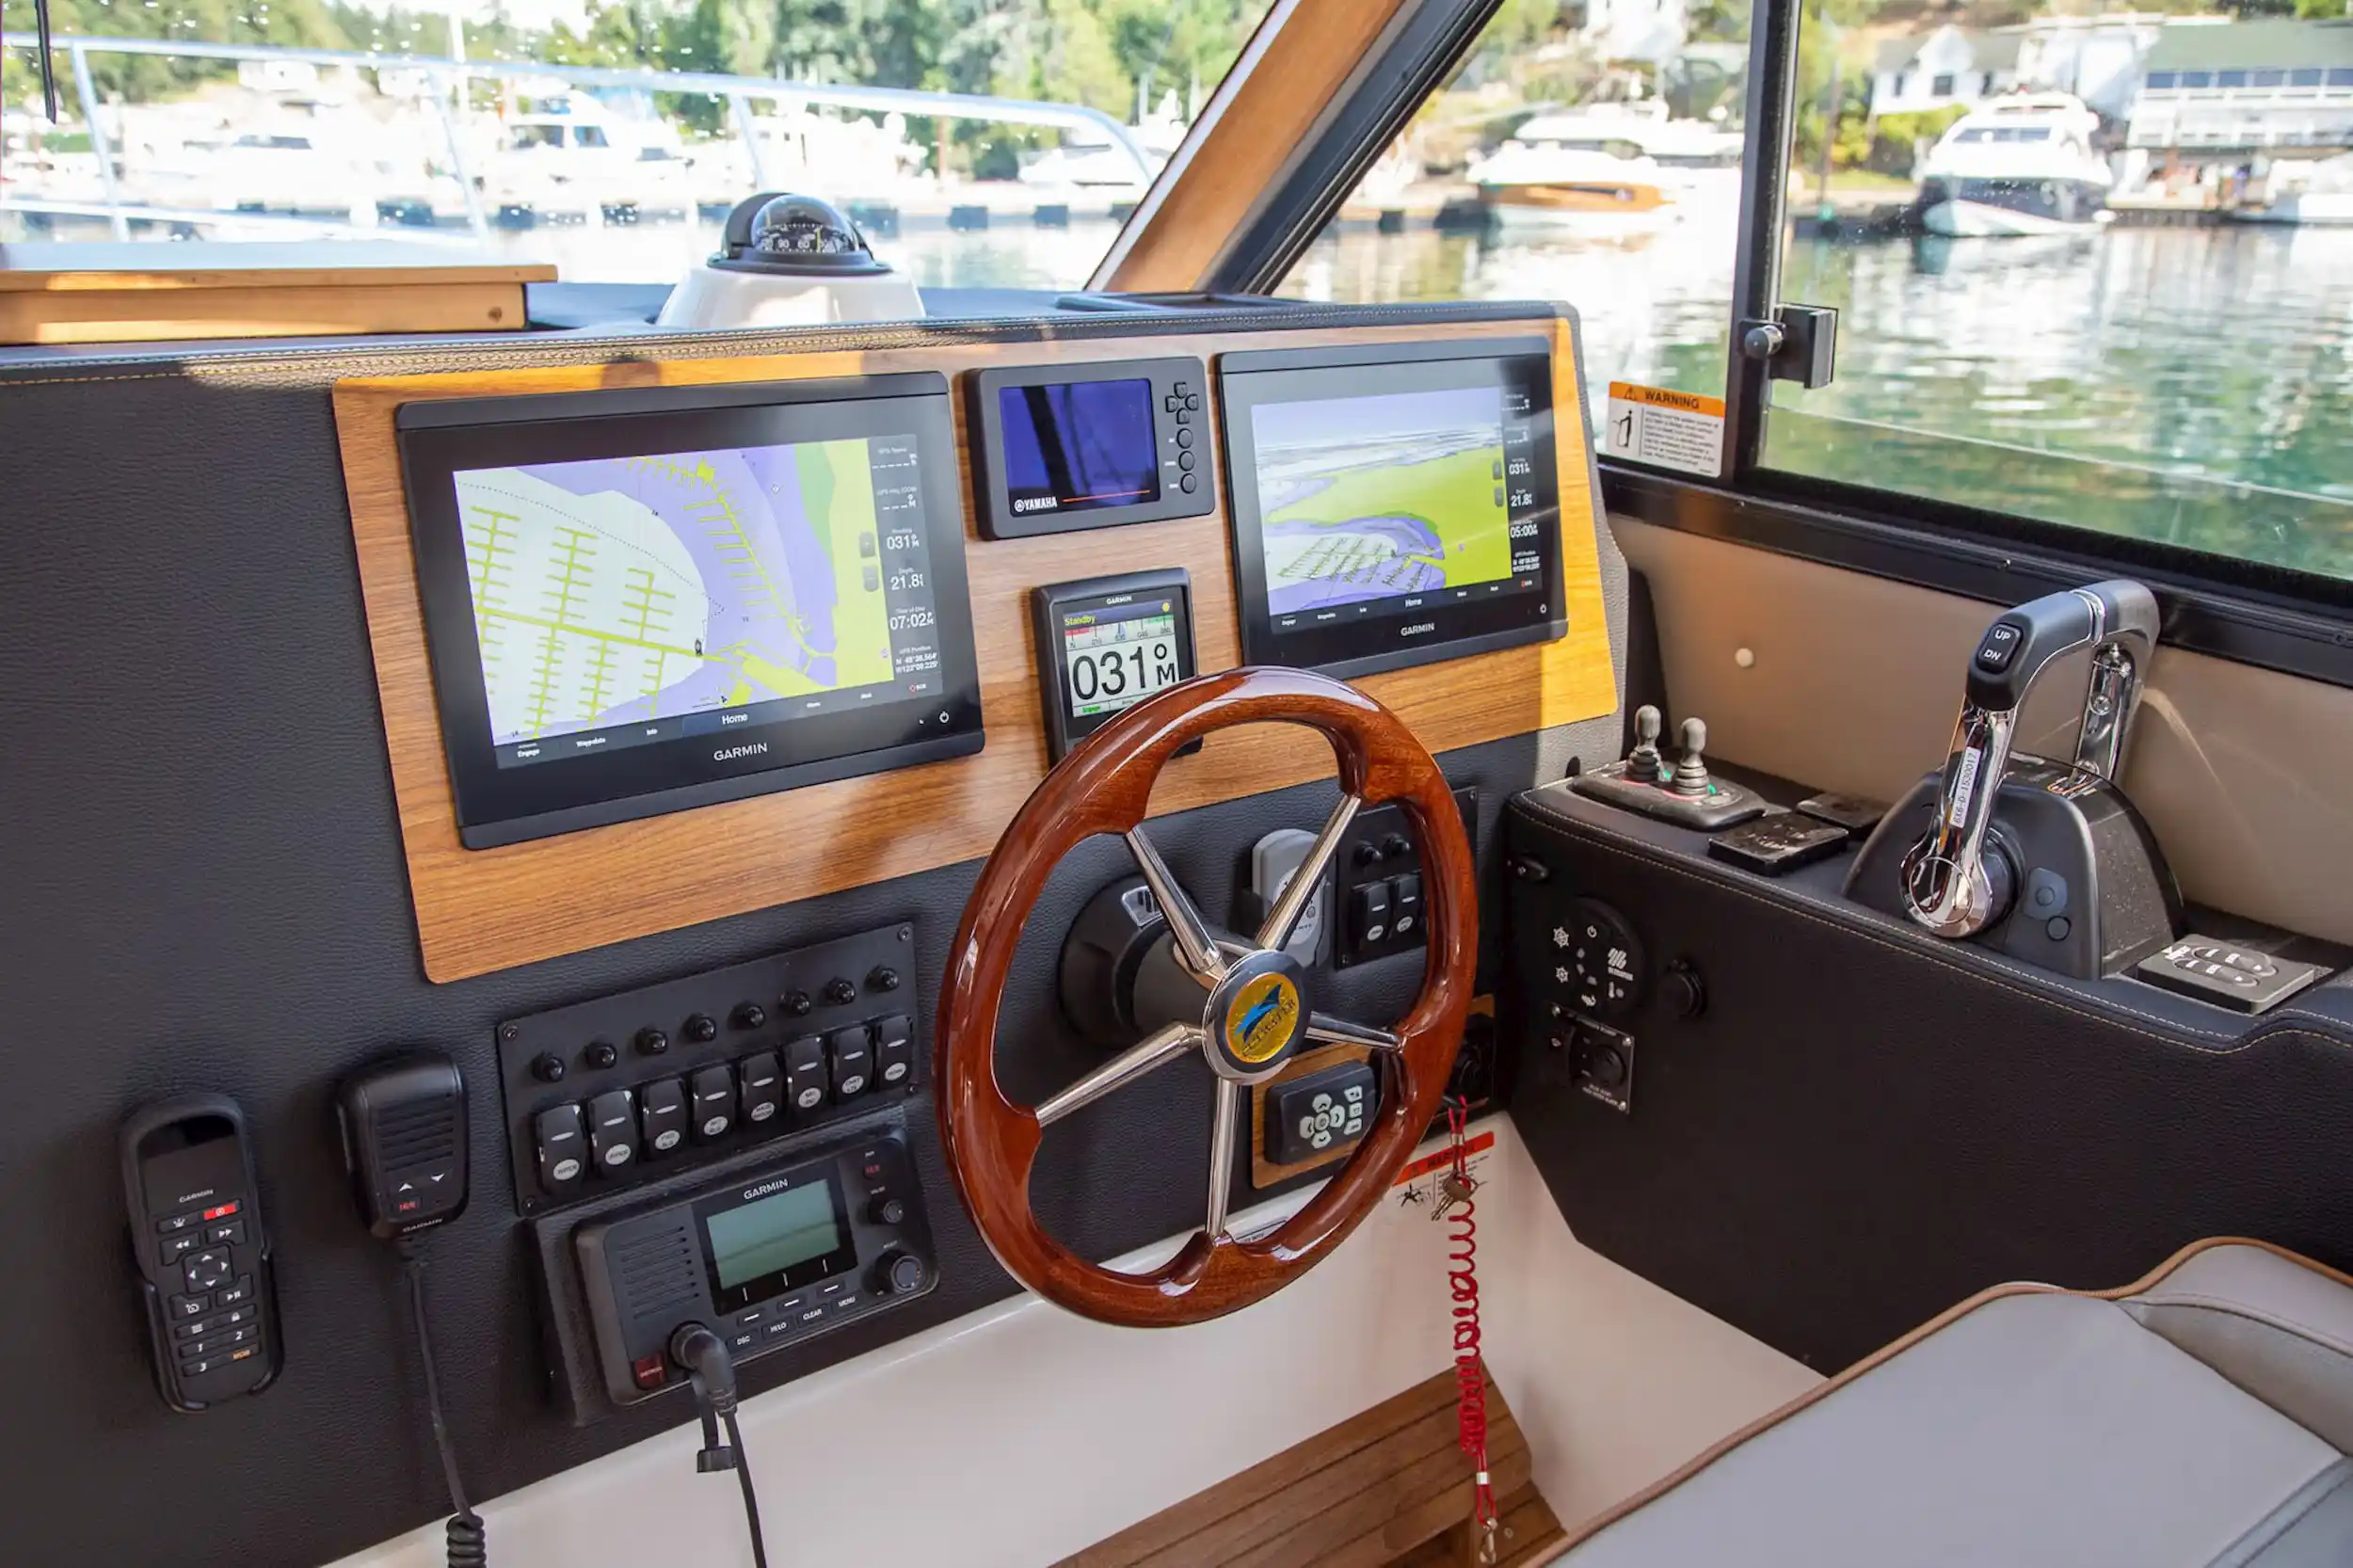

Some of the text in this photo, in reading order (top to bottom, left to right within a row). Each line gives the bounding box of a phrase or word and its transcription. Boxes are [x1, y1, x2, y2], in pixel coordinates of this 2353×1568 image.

[1645, 391, 1700, 409] WARNING
[1024, 496, 1059, 511] YAMAHA
[1105, 595, 1133, 605] GARMIN
[1064, 614, 1096, 627] Standby
[1400, 622, 1435, 637] GARMIN
[1994, 629, 2011, 642] UP
[1983, 648, 2002, 662] DN
[721, 712, 749, 727] Home
[712, 743, 769, 762] GARMIN
[744, 1177, 789, 1200] GARMIN
[178, 1189, 215, 1204] GARMIN
[802, 1308, 823, 1320] CLEAR
[235, 1331, 244, 1340] 2
[736, 1335, 751, 1347] DSC
[199, 1362, 207, 1372] 3
